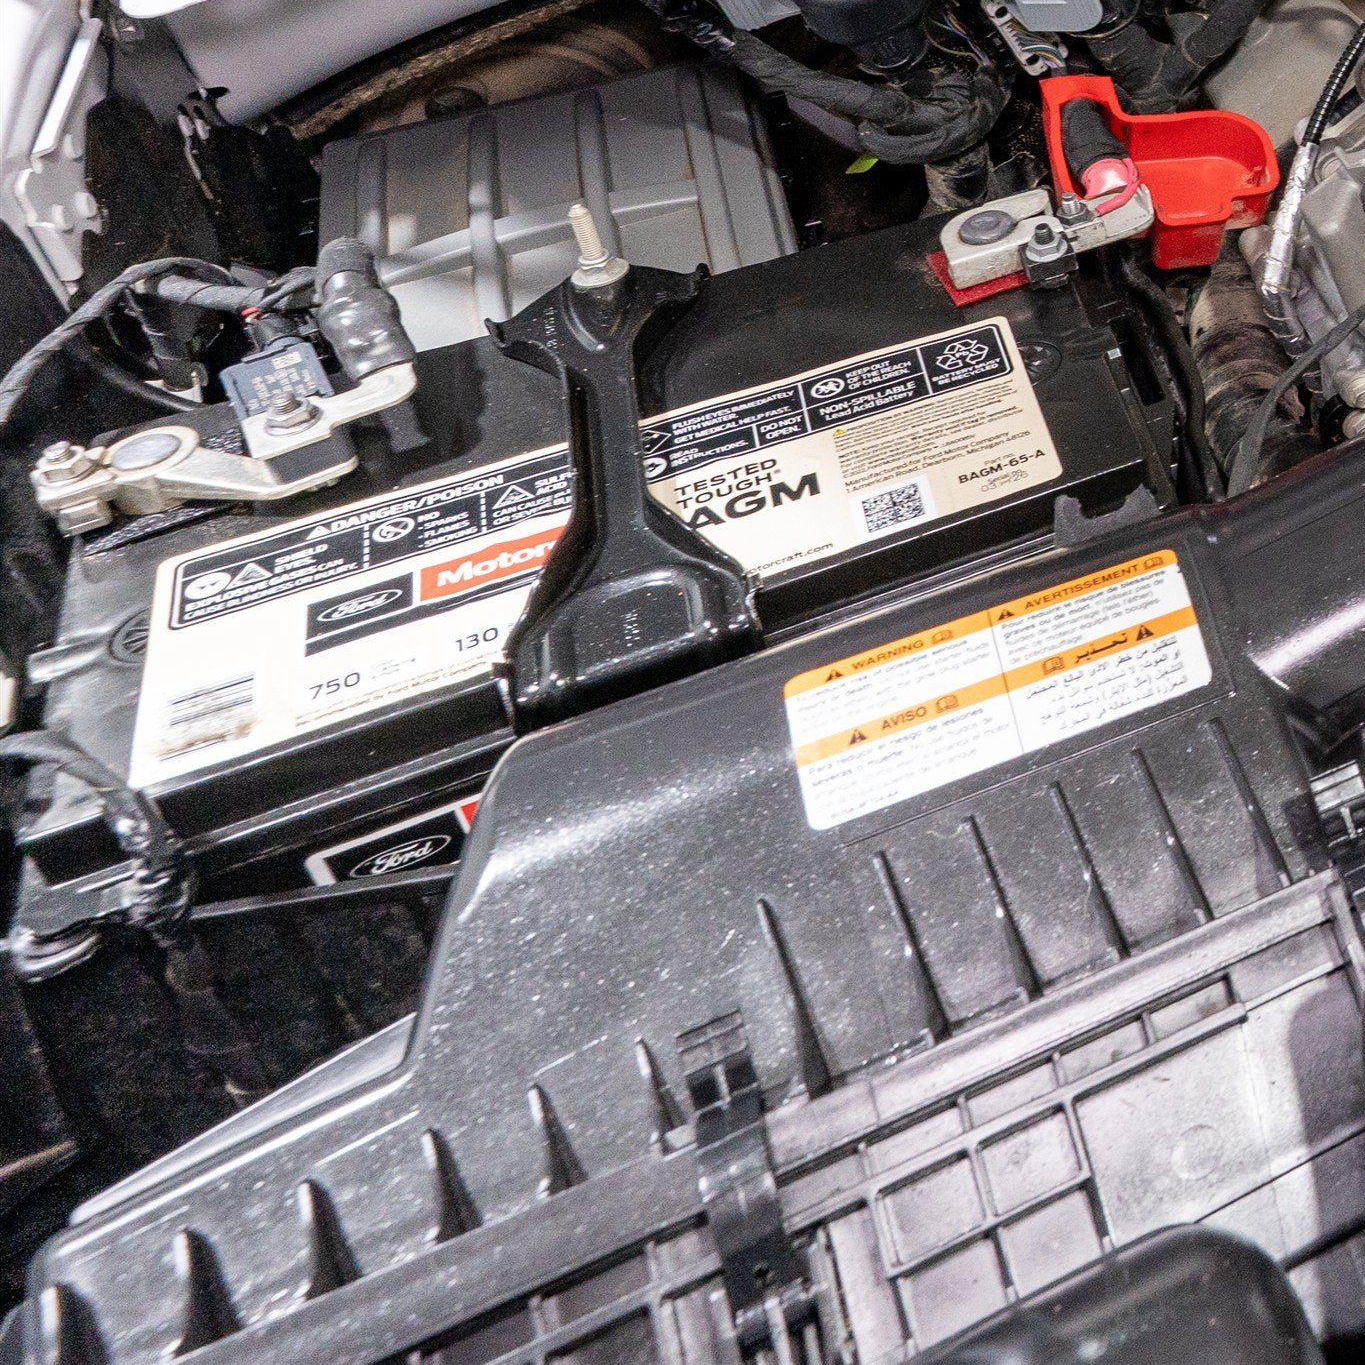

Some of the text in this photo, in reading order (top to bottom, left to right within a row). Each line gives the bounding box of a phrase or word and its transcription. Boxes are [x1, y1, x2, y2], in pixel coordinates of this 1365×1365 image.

[844, 360, 891, 378] KEEP OUT
[845, 360, 912, 384] OF THE REACH
[847, 366, 910, 390] OF CHILDREN.
[931, 356, 1001, 382] BATTERY MUST
[936, 362, 999, 385] BE RECYCLED
[671, 389, 795, 430] FLUSH EYES IMMEDIATELY
[817, 380, 917, 416] NON-SPILLABLE
[824, 388, 915, 421] Lead Acid Battery
[673, 404, 792, 444] GET MEDICAL HELP FAST.
[758, 414, 804, 433] DO NOT
[763, 423, 801, 440] OPEN.
[668, 446, 699, 461] READ
[921, 451, 943, 462] Ford
[943, 443, 969, 455] Motor
[969, 430, 1009, 447] Company
[673, 456, 778, 497] TESTED
[956, 447, 1046, 484] BAGM-65-A
[535, 479, 568, 496] ACID
[684, 471, 823, 533] AGM
[330, 472, 504, 533] DANGER/POISON
[416, 509, 440, 523] NO
[274, 542, 328, 566] SHIELD
[744, 541, 834, 576] otorcraft.com
[184, 557, 344, 612] EXPLOSIVE GASES CAN
[1025, 564, 1139, 610] AVERTISSEMENT
[455, 627, 499, 652] 130
[852, 640, 925, 670] WARNING
[309, 672, 361, 701] 750
[881, 707, 927, 731] AVISO
[370, 841, 434, 874] Ford
